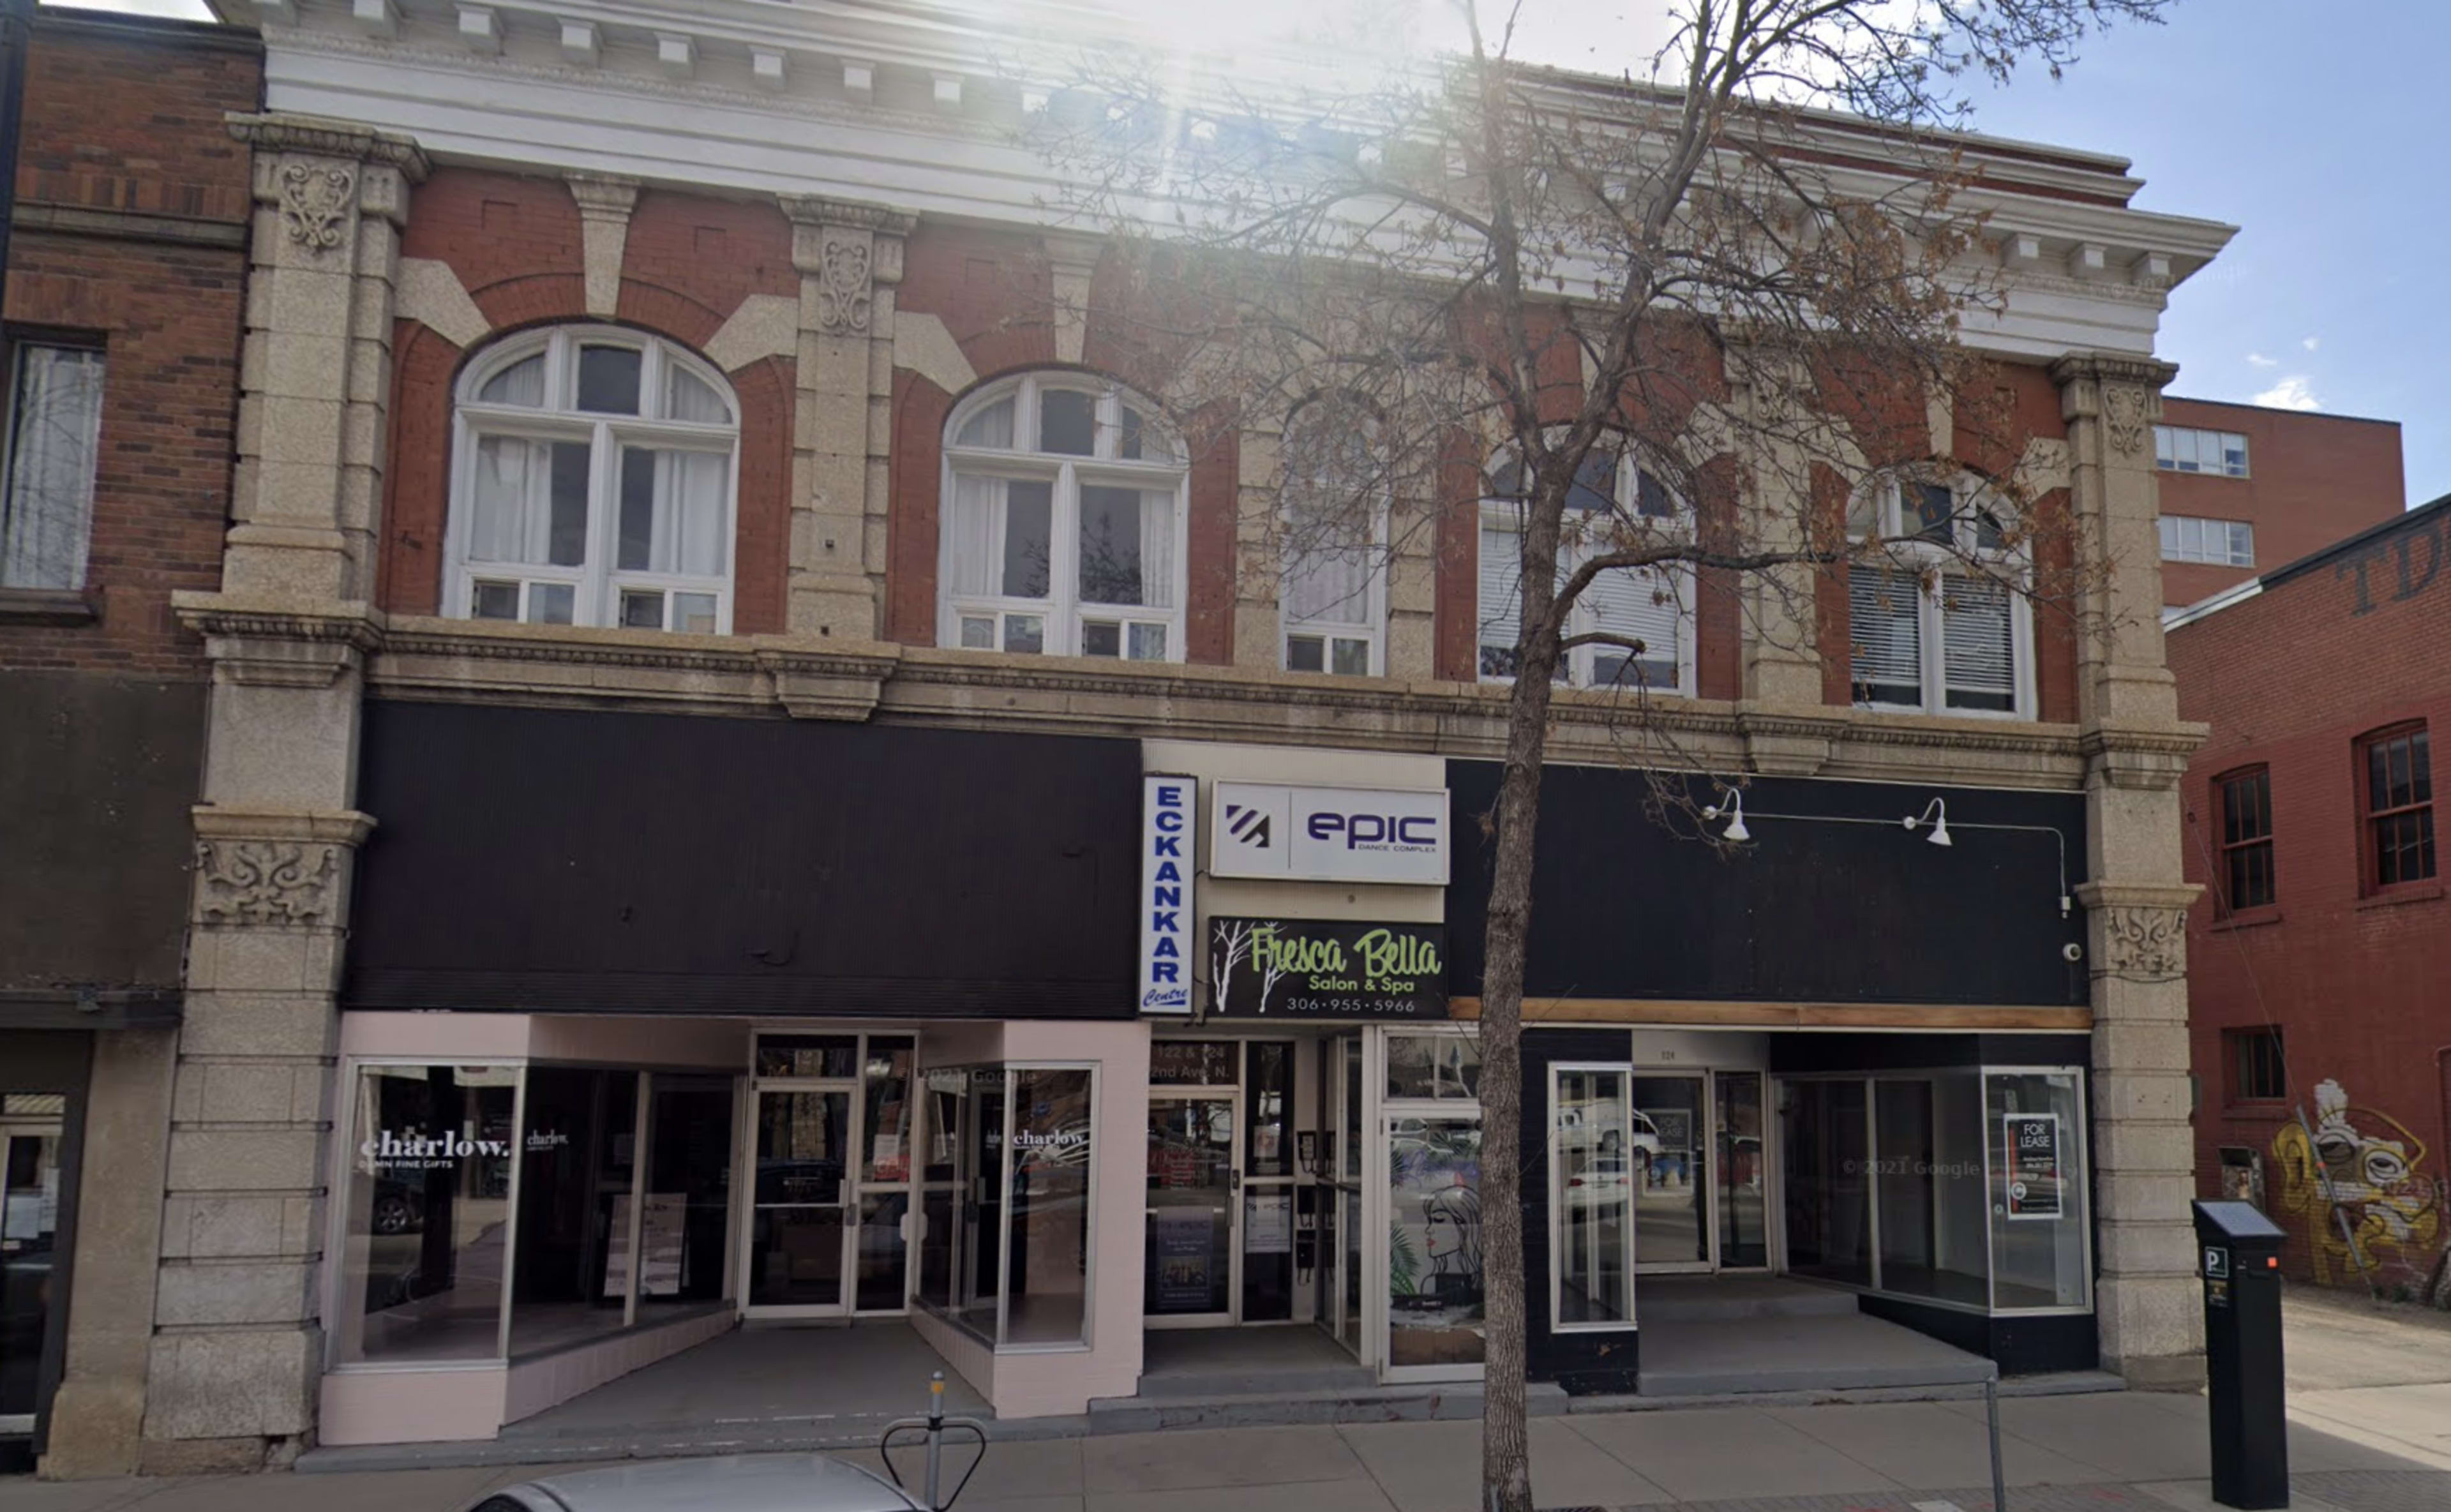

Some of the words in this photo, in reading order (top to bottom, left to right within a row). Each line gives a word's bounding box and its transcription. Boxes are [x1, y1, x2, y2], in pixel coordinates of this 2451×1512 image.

[1307, 812, 1436, 850] epic
[1358, 844, 1390, 852] DANCE
[1152, 786, 1183, 983] ECKANKAR
[1252, 927, 1347, 973] Fresca
[1353, 929, 1442, 978] Bella
[1309, 975, 1358, 991] Salon
[1364, 978, 1376, 991] &
[1381, 977, 1414, 995] Spa
[1143, 989, 1188, 1007] Centre
[2024, 1123, 2046, 1135] FOR
[361, 1130, 509, 1156] charlow.
[2020, 1136, 2050, 1148] LEASE
[395, 1160, 421, 1169] FINE
[424, 1160, 454, 1169] GIFTS
[2207, 1251, 2219, 1271] P
